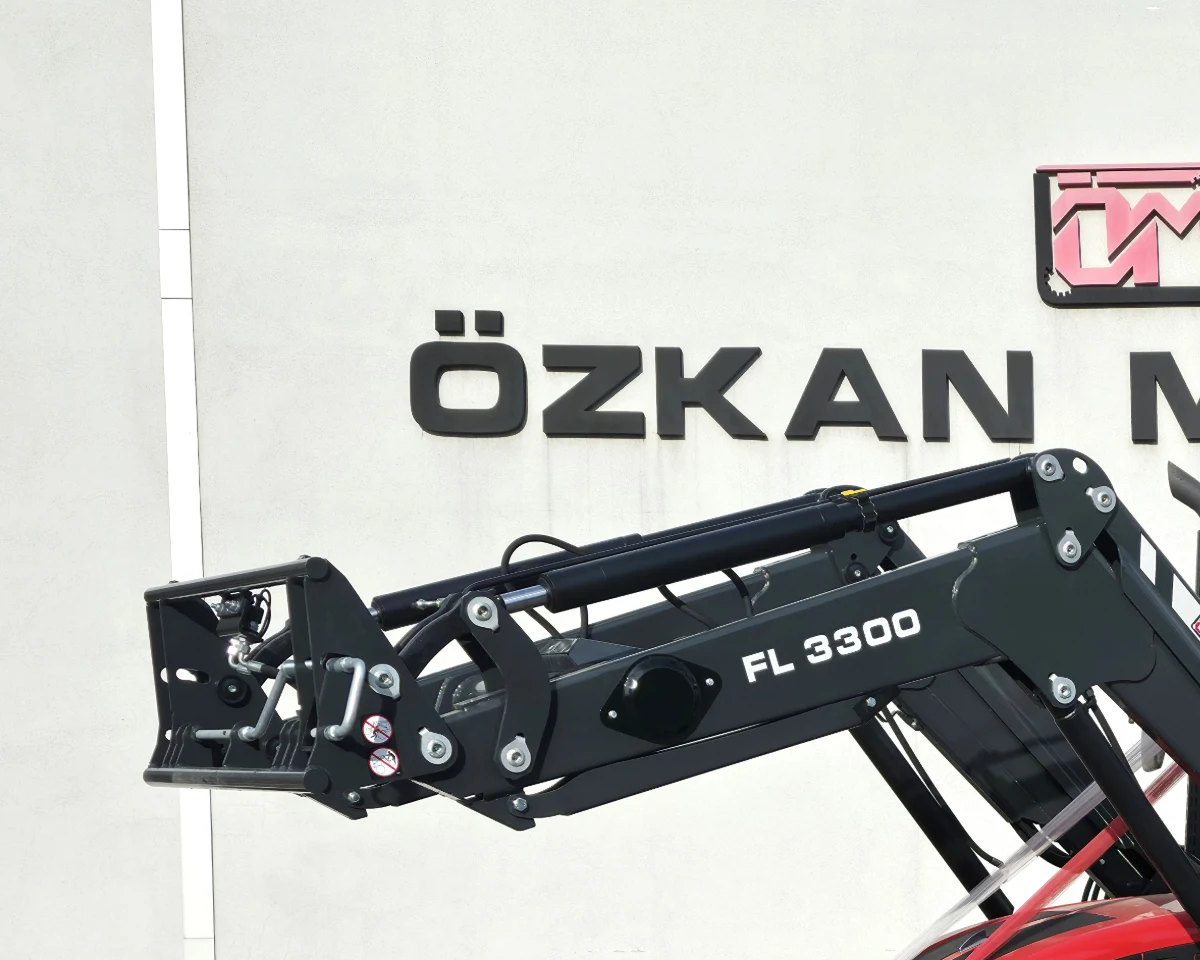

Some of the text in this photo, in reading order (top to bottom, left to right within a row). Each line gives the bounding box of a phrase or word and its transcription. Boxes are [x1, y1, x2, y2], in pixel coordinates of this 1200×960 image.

[409, 309, 1034, 443] ÖZKAN
[742, 608, 921, 683] FL 3300
